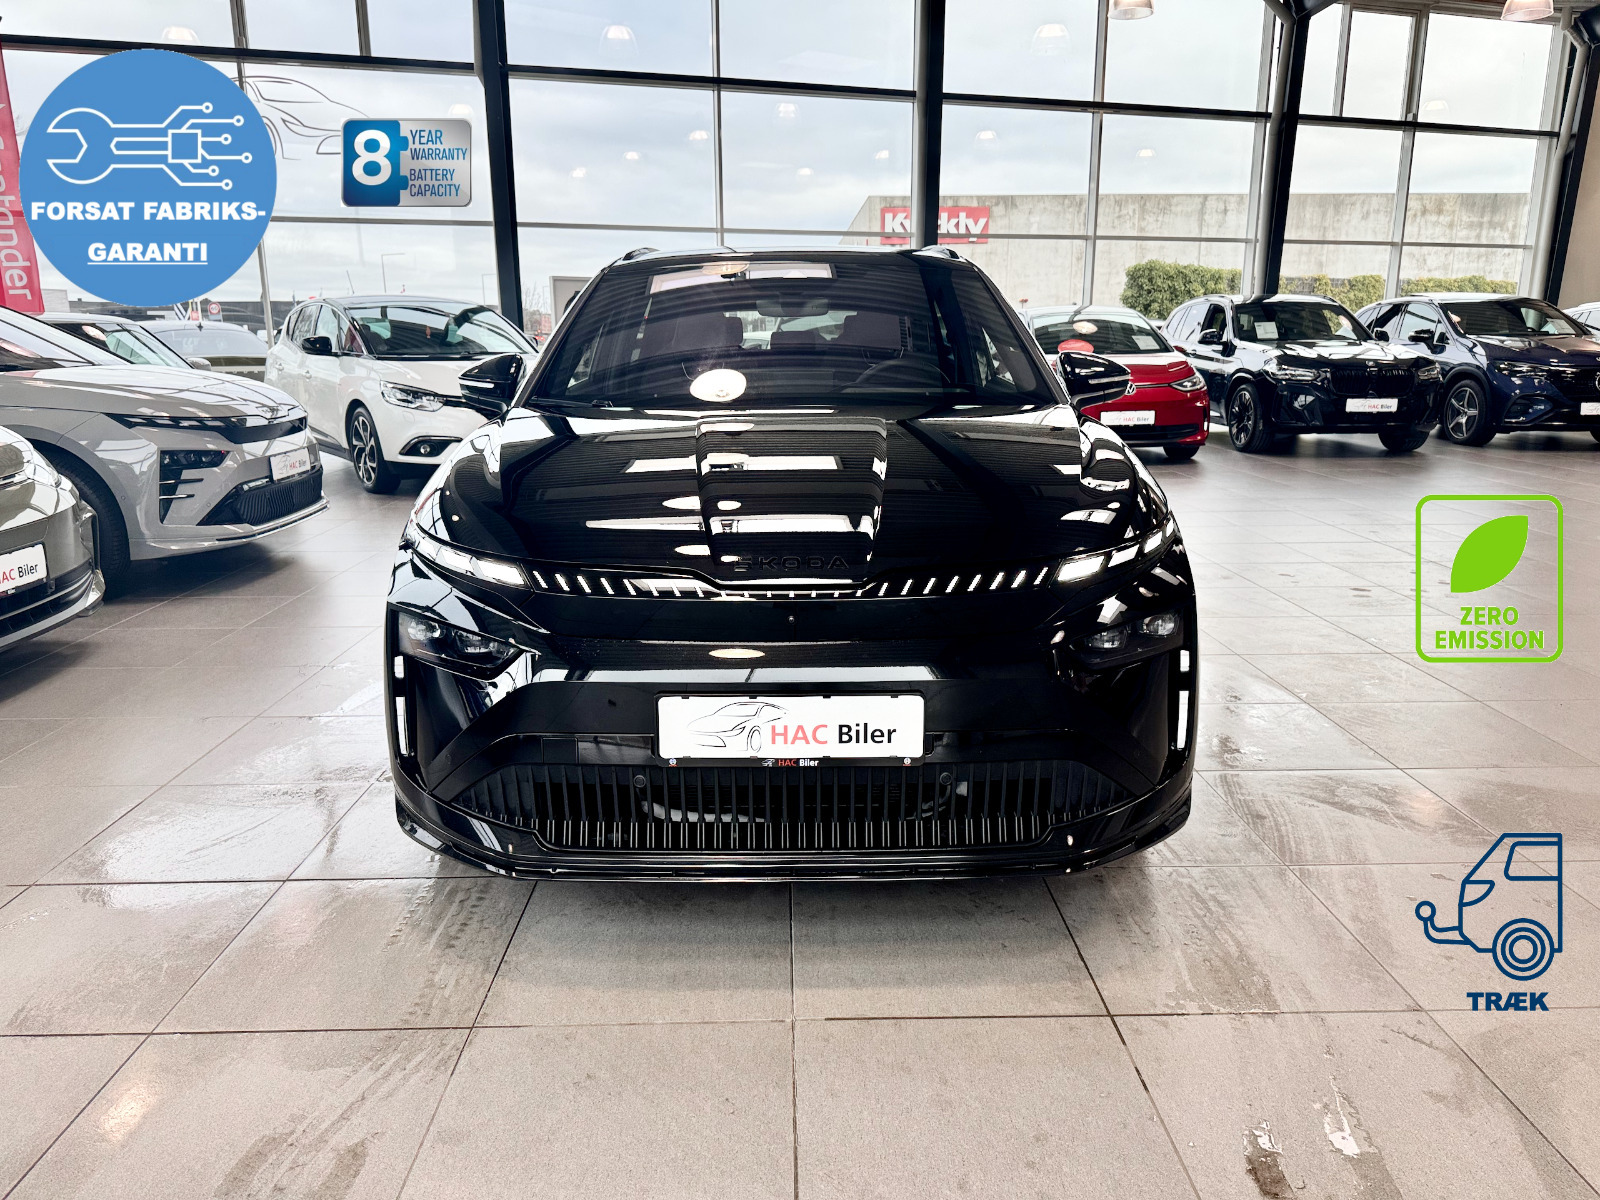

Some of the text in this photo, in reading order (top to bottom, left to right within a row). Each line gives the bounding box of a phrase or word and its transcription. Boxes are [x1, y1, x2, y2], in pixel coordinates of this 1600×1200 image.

[0, 563, 38, 584] AC Biler
[770, 723, 897, 745] HAC Biler
